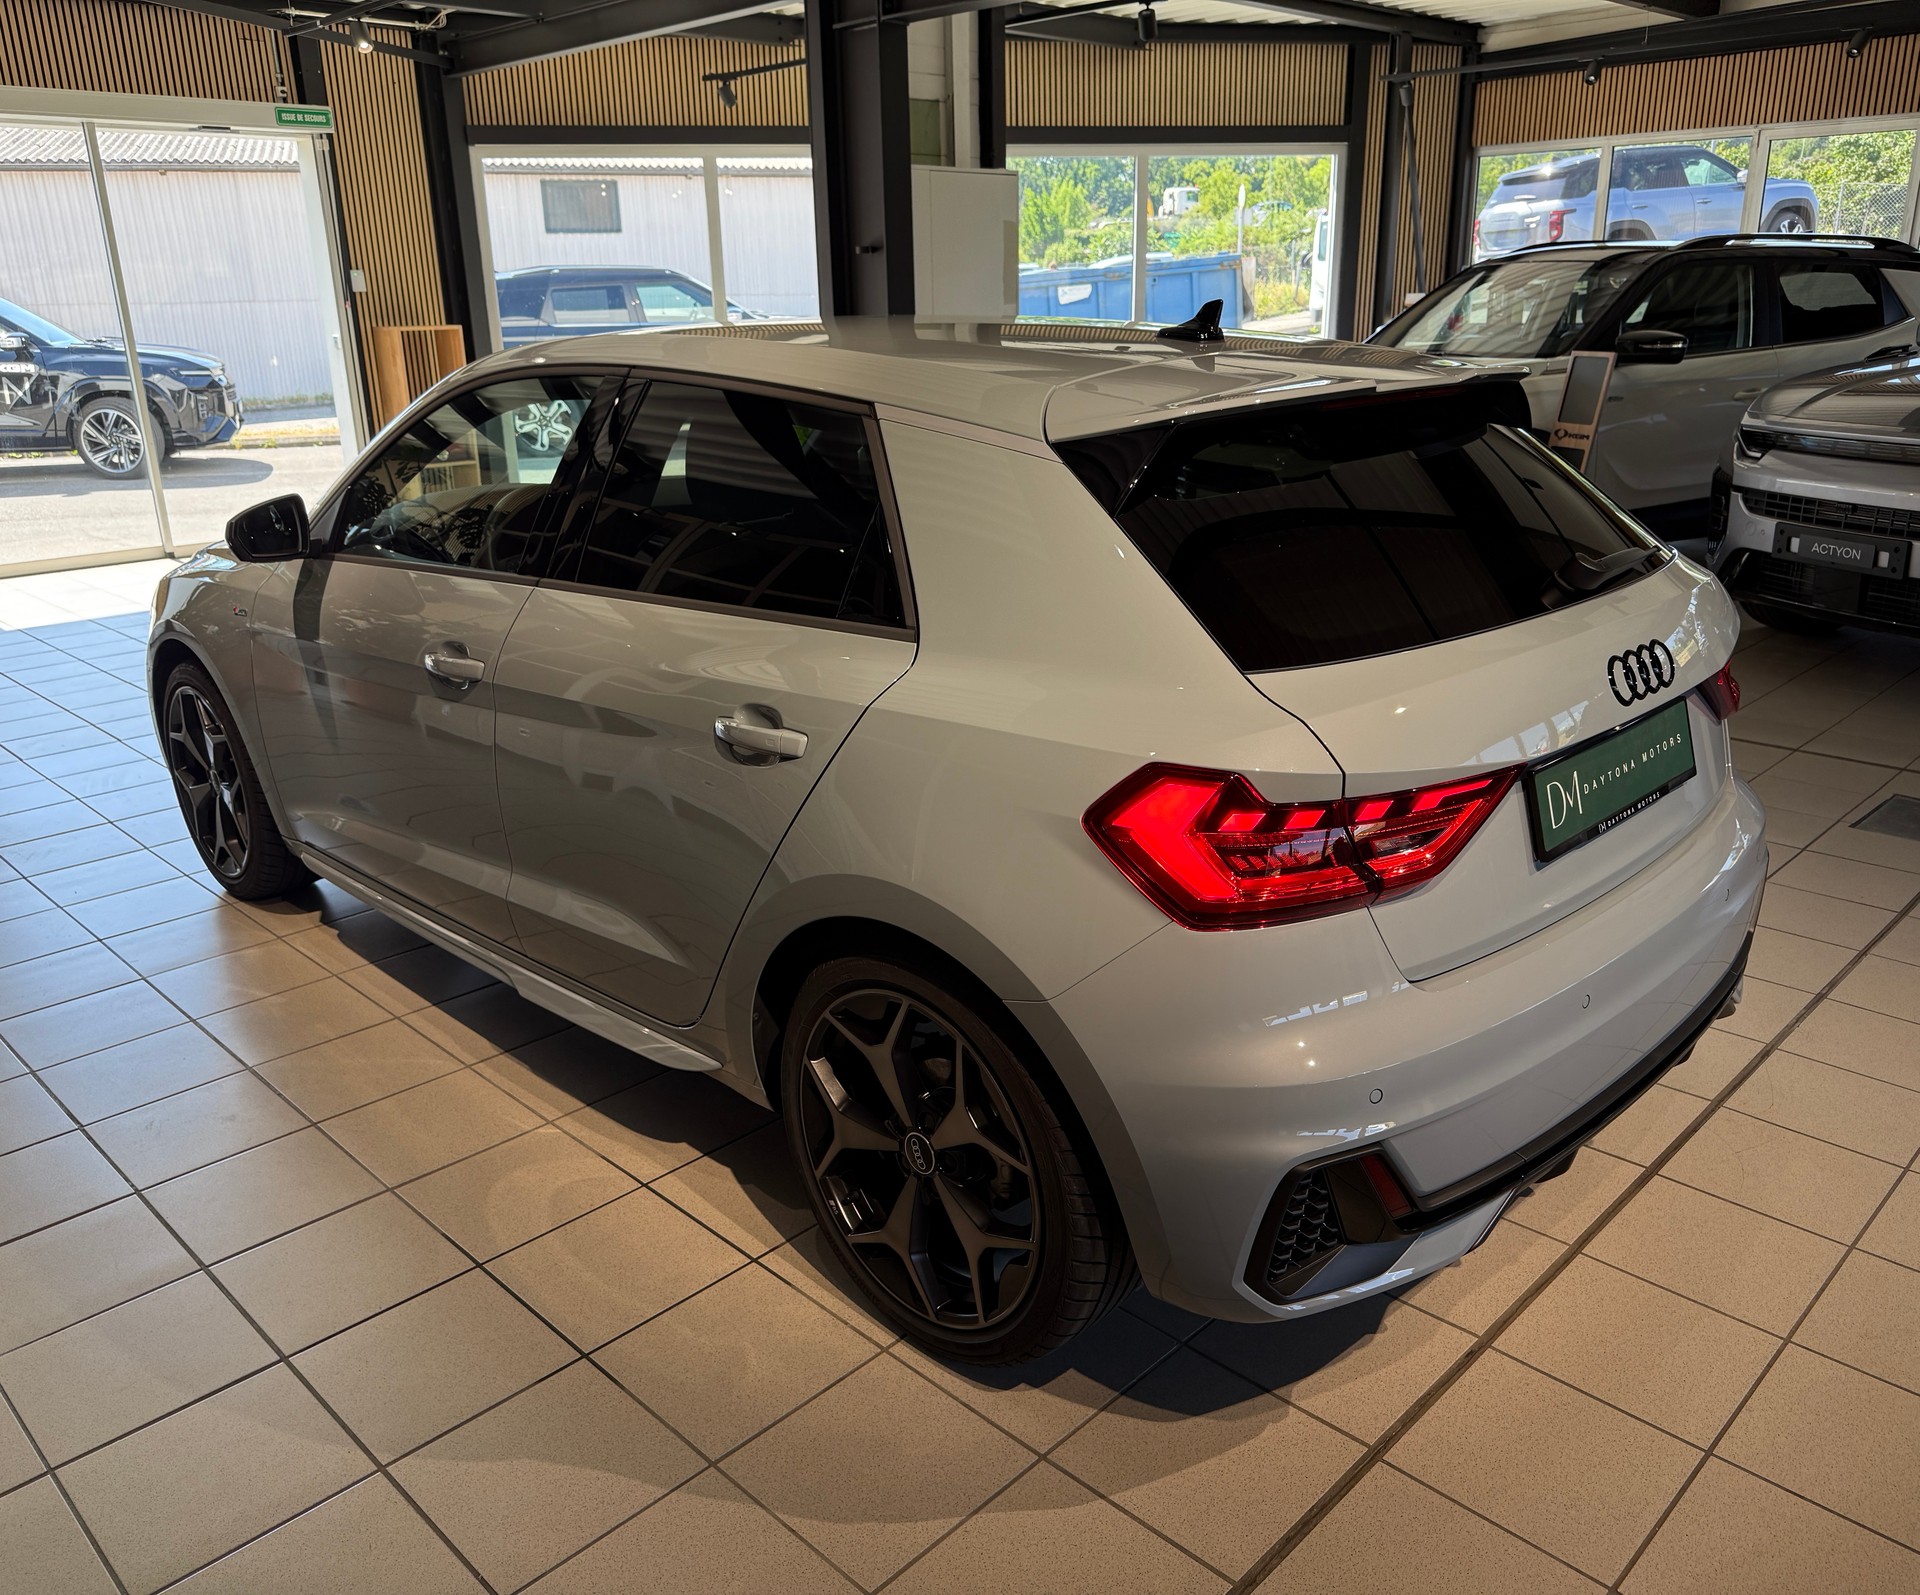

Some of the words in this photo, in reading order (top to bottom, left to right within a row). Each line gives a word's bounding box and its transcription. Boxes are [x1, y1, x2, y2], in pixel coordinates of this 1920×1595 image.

[281, 113, 296, 121] ISSUE
[297, 113, 304, 122] DE
[304, 114, 326, 123] SECOURS
[1811, 542, 1861, 560] ACTYON
[1583, 759, 1636, 795] DAYTONA
[1641, 733, 1682, 763] MOTORS
[1607, 807, 1635, 827] DAYTONA
[1637, 791, 1660, 809] MOTORS
